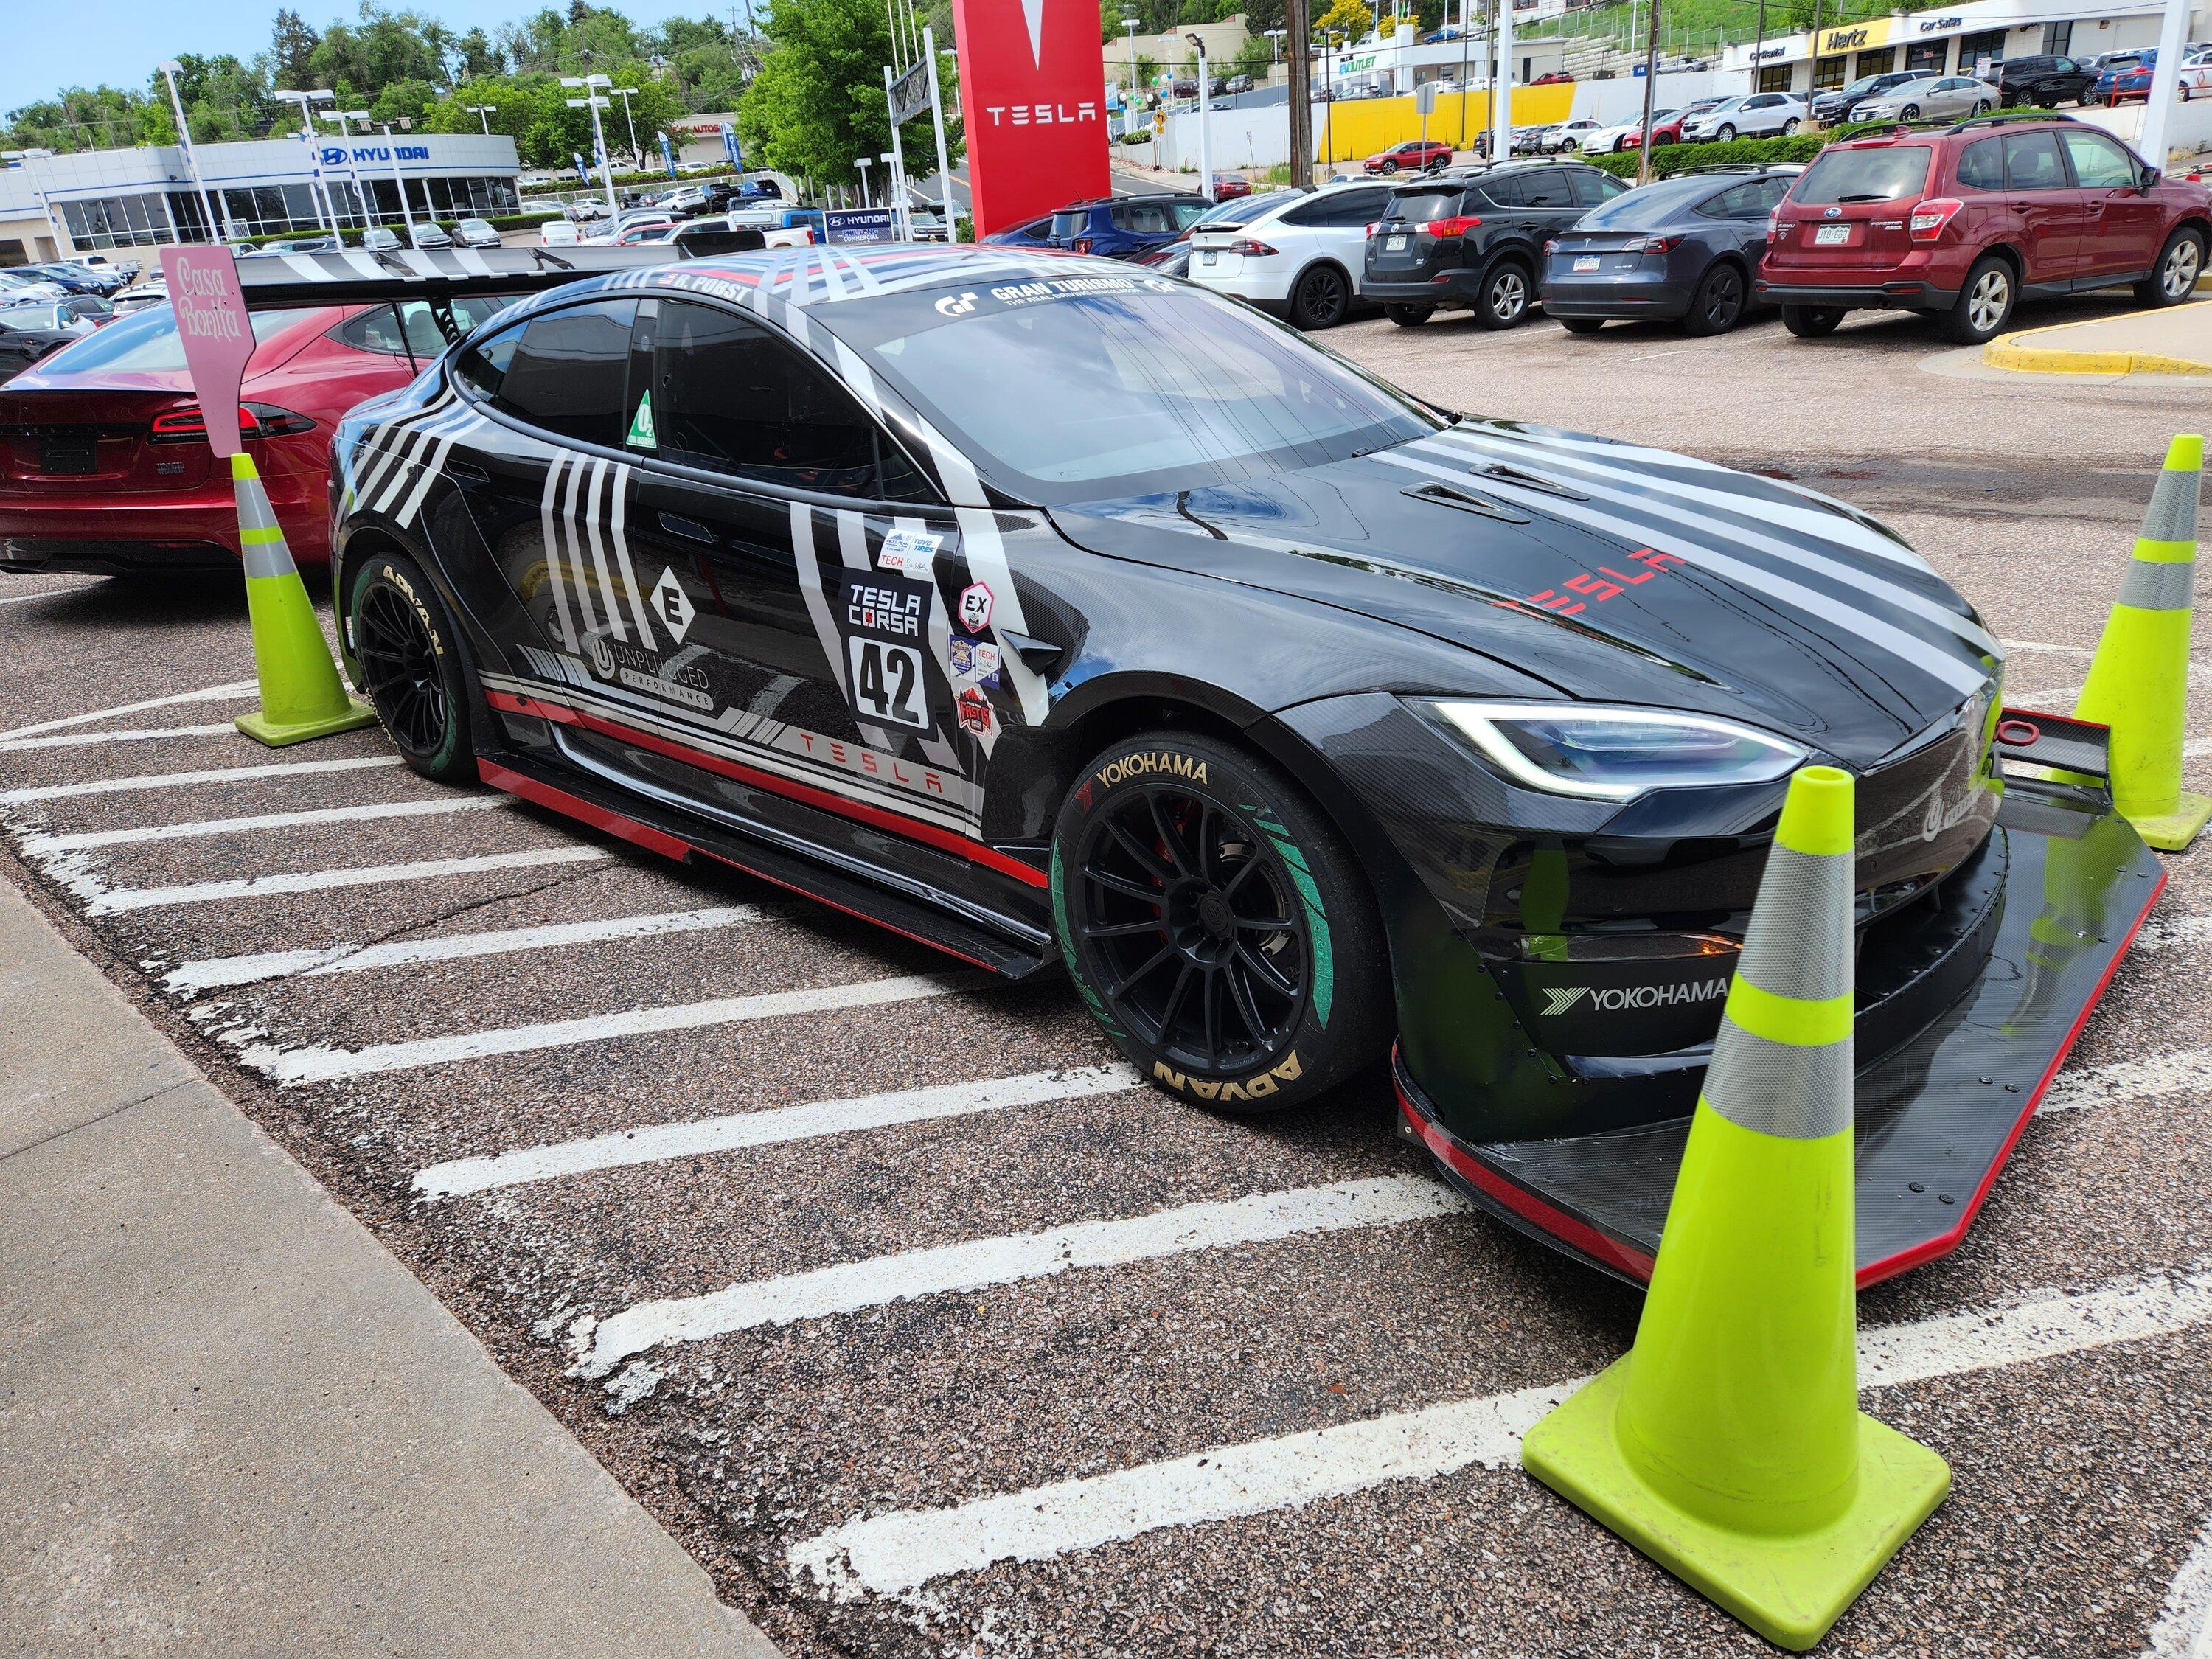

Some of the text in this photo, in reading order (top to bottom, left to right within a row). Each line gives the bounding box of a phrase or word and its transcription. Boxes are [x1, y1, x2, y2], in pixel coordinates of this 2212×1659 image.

[1826, 29, 1868, 50] Hertz
[1920, 18, 1962, 32] Car Sales
[1761, 46, 1786, 59] Rental
[986, 102, 1096, 126] TESLA
[846, 214, 890, 225] HYUNDAI
[843, 234, 879, 243] COMMERCIAL
[177, 257, 227, 296] Casa
[672, 274, 753, 302] R. POBST
[991, 278, 1136, 300] GRAN TURISMO
[178, 296, 242, 342] Bonita
[881, 554, 904, 566] TECH
[914, 545, 935, 553] TIRES
[1491, 547, 1687, 616] ESLA
[382, 565, 444, 655] ADVAN
[661, 585, 684, 626] E
[850, 584, 922, 616] TESLA
[964, 594, 987, 614] EX
[848, 605, 919, 637] CORSA
[616, 644, 709, 689] UNPLUGGED
[977, 649, 995, 661] TECH
[625, 672, 709, 706] PERFORMANCE
[859, 642, 920, 725] 42
[799, 733, 942, 793] TESLA
[1096, 751, 1208, 789] YOKOHAMA
[1590, 978, 1728, 1011] YOKOHAMA
[1153, 1049, 1303, 1102] ADVAN
